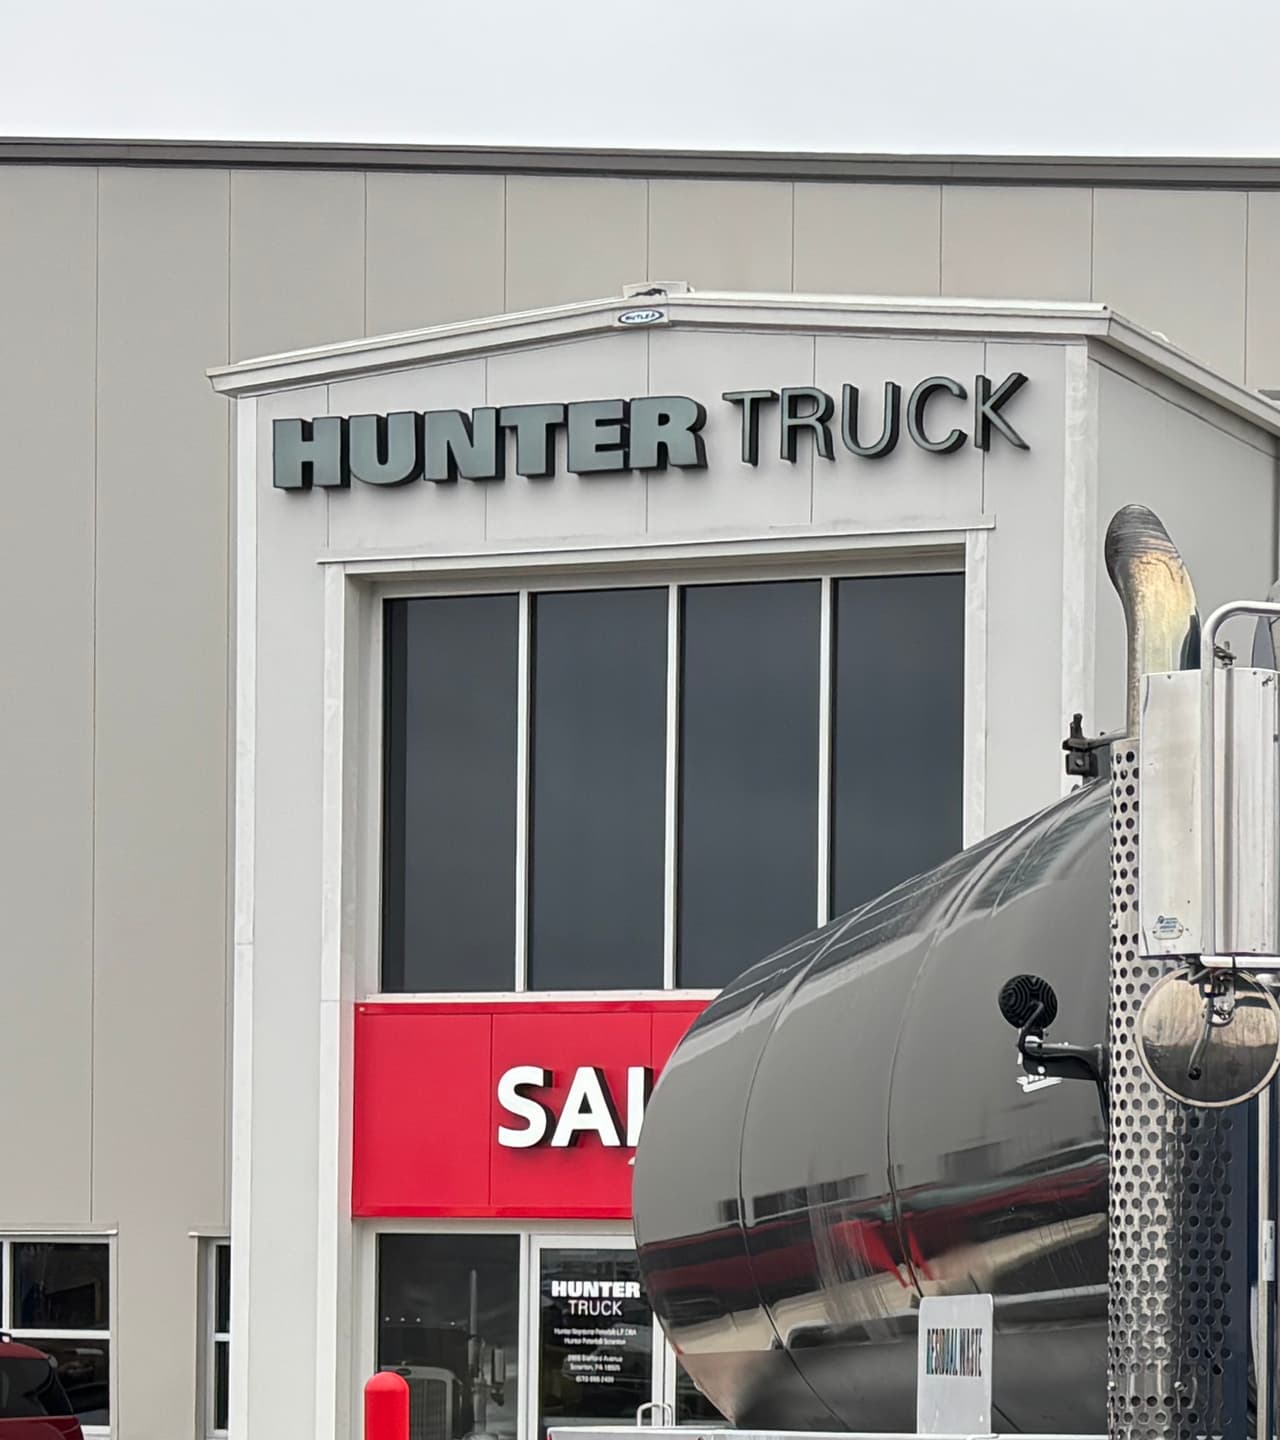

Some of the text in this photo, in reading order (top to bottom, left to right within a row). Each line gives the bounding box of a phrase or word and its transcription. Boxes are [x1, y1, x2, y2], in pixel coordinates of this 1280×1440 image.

[273, 372, 1030, 488] HUNTER TRUCK
[551, 1280, 640, 1298] HUNTER
[567, 1300, 623, 1316] TRUCK
[959, 1327, 983, 1378] WASTE
